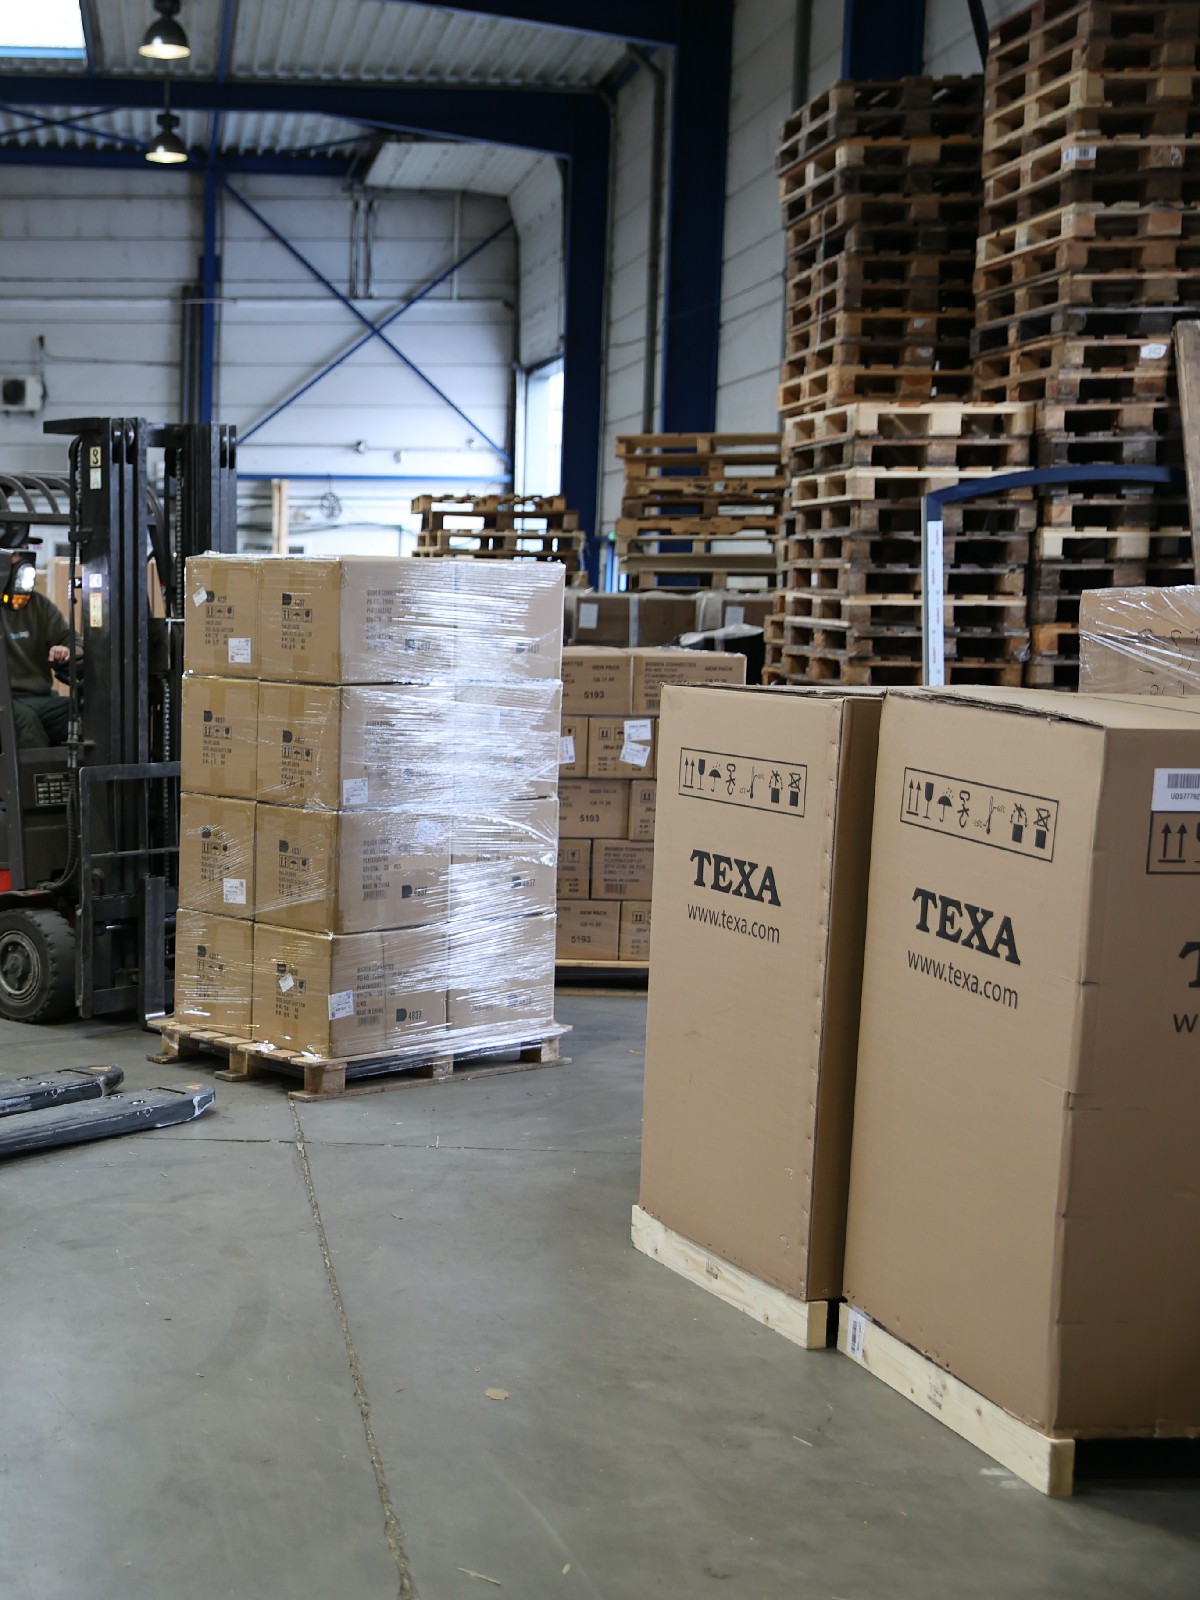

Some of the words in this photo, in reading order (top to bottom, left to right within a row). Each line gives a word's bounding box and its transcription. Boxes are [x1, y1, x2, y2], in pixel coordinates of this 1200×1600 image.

[584, 690, 604, 699] 5193
[580, 814, 600, 822] 5193
[690, 850, 781, 907] TEXA
[687, 904, 780, 944] www.texa.com
[912, 888, 1021, 966] TEXA
[571, 935, 591, 943] 5193
[907, 949, 1018, 1010] www.texa.com
[408, 1010, 422, 1020] 4837
